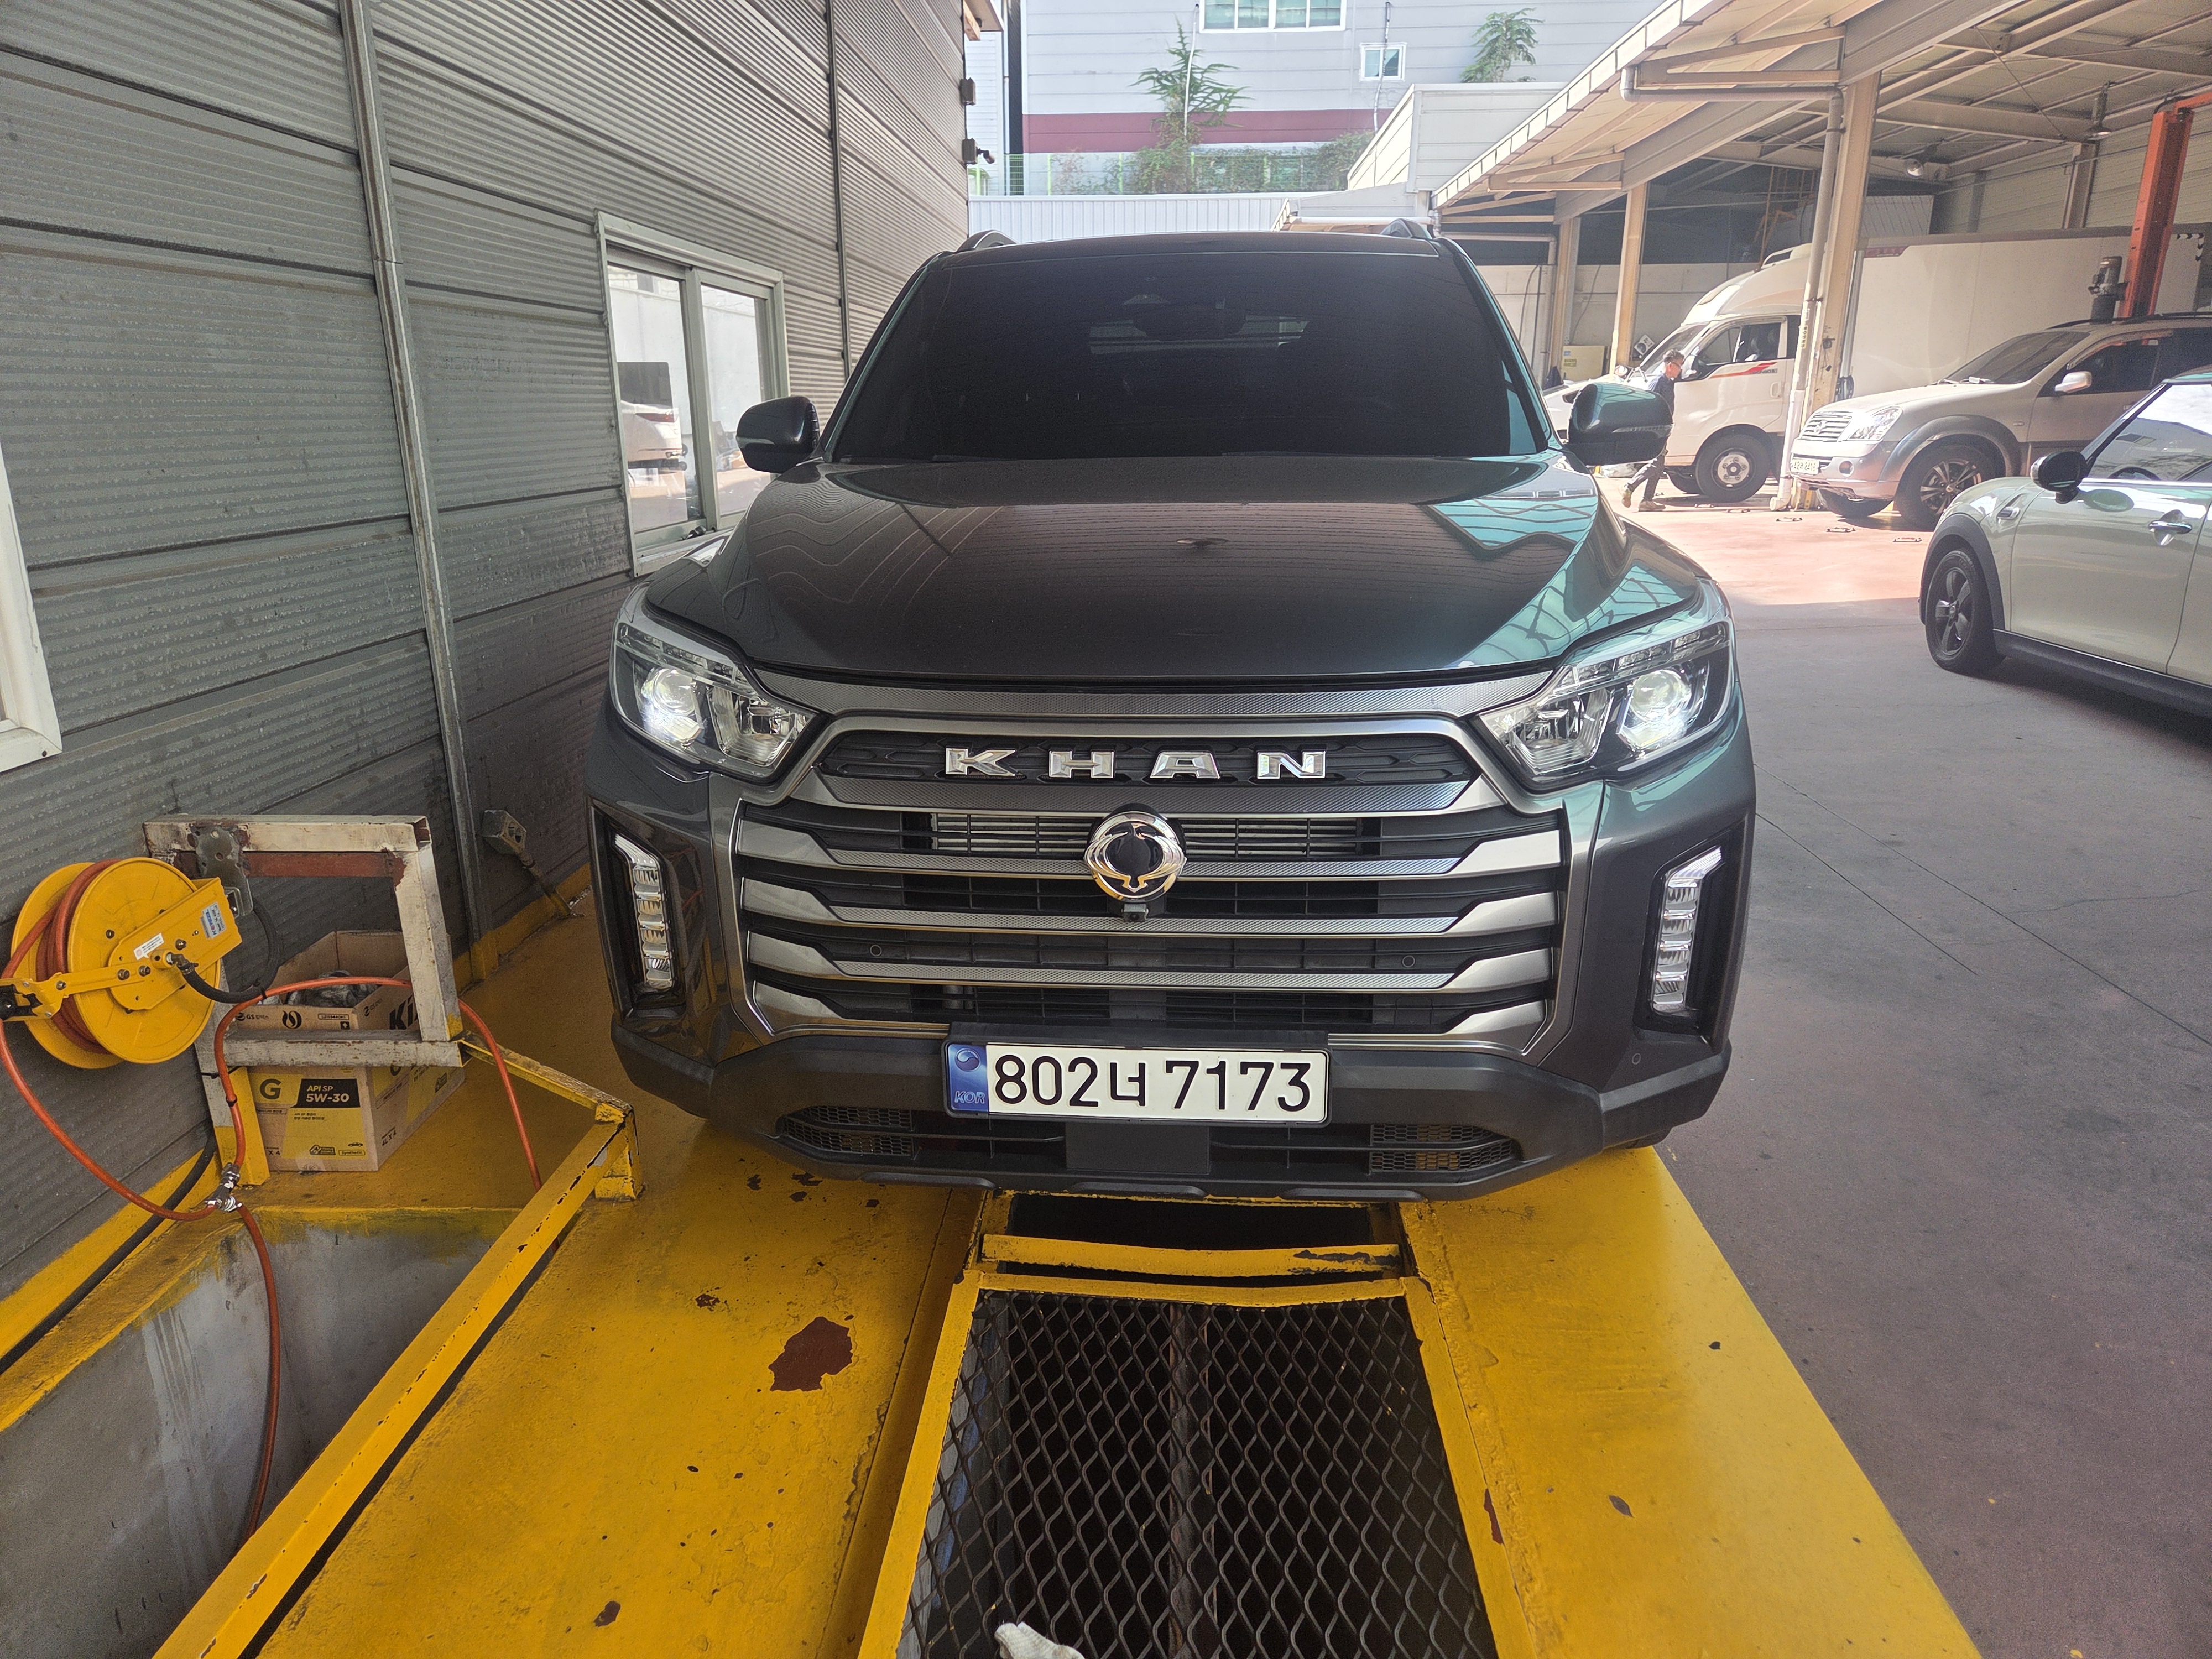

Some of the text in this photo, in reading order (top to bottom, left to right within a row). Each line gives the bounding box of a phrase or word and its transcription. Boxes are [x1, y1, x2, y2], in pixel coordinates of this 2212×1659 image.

[946, 747, 1326, 780] KHAN
[260, 1078, 282, 1100] G
[995, 1054, 1311, 1112] 802너 7173
[306, 1093, 349, 1102] 5W-30
[954, 1090, 985, 1104] KOR
